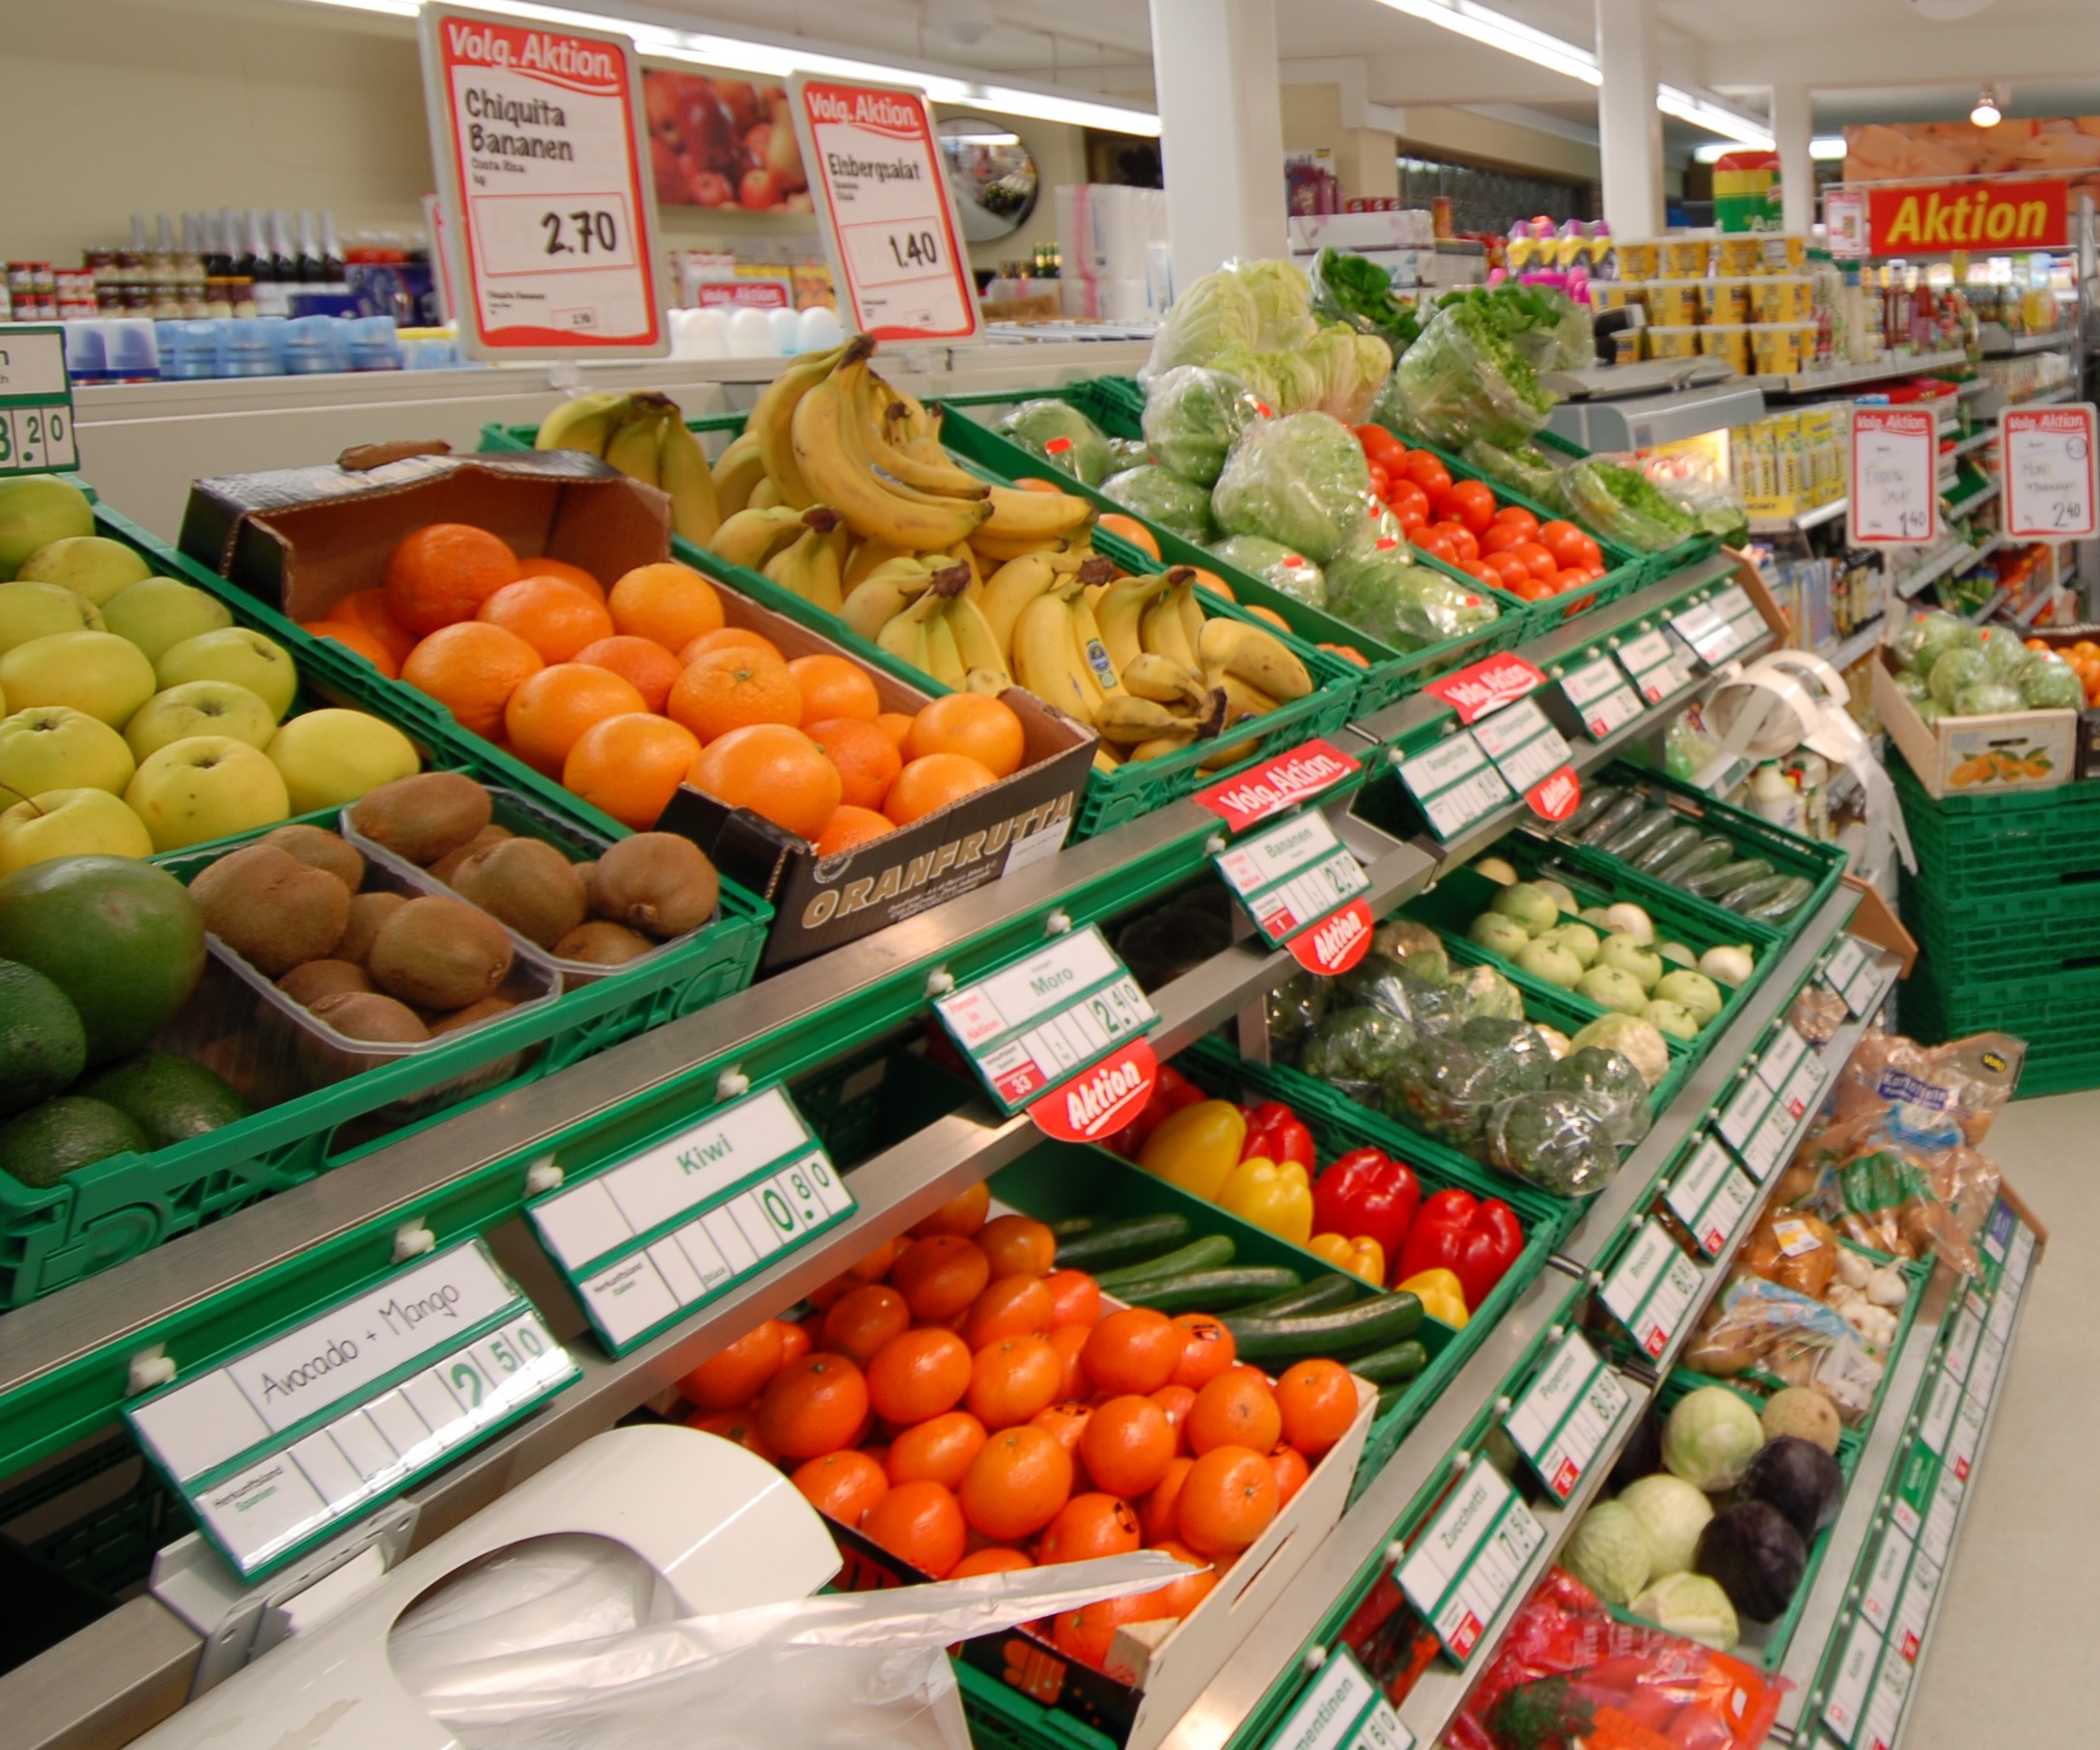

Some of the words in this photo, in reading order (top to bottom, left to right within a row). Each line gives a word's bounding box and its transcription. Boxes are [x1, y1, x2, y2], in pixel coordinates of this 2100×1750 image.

[449, 23, 517, 68] Volg.
[521, 34, 618, 80] Aktion.
[466, 88, 566, 128] Chiquita
[807, 92, 853, 123] Volg.
[855, 95, 920, 127] Aktion.
[469, 124, 574, 162] Bananen
[827, 153, 920, 181] Eisbergsalat
[540, 209, 617, 255] 2.70
[1887, 190, 2048, 245] Aktion
[888, 232, 937, 268] 1.40
[1219, 784, 1283, 815] Volg.
[1266, 754, 1342, 794] Aktion.
[802, 791, 1075, 929] ORANFRUTTA
[1263, 828, 1313, 858] Bananen
[1313, 911, 1363, 966] Aktion
[1030, 966, 1074, 997] Moro
[1092, 984, 1140, 1034] 2.40
[1012, 1075, 1033, 1096] 33
[1067, 1061, 1141, 1130] Aktion
[676, 1133, 734, 1175] Kiwi
[762, 1162, 830, 1233] 0.80
[260, 1337, 358, 1404] Avocado
[378, 1282, 460, 1337] Mango
[1538, 1352, 1575, 1402] Peperoni
[213, 1465, 285, 1511] Herkunftsland
[235, 1484, 277, 1514] Spanien
[1438, 1484, 1489, 1551] Zucchetti
